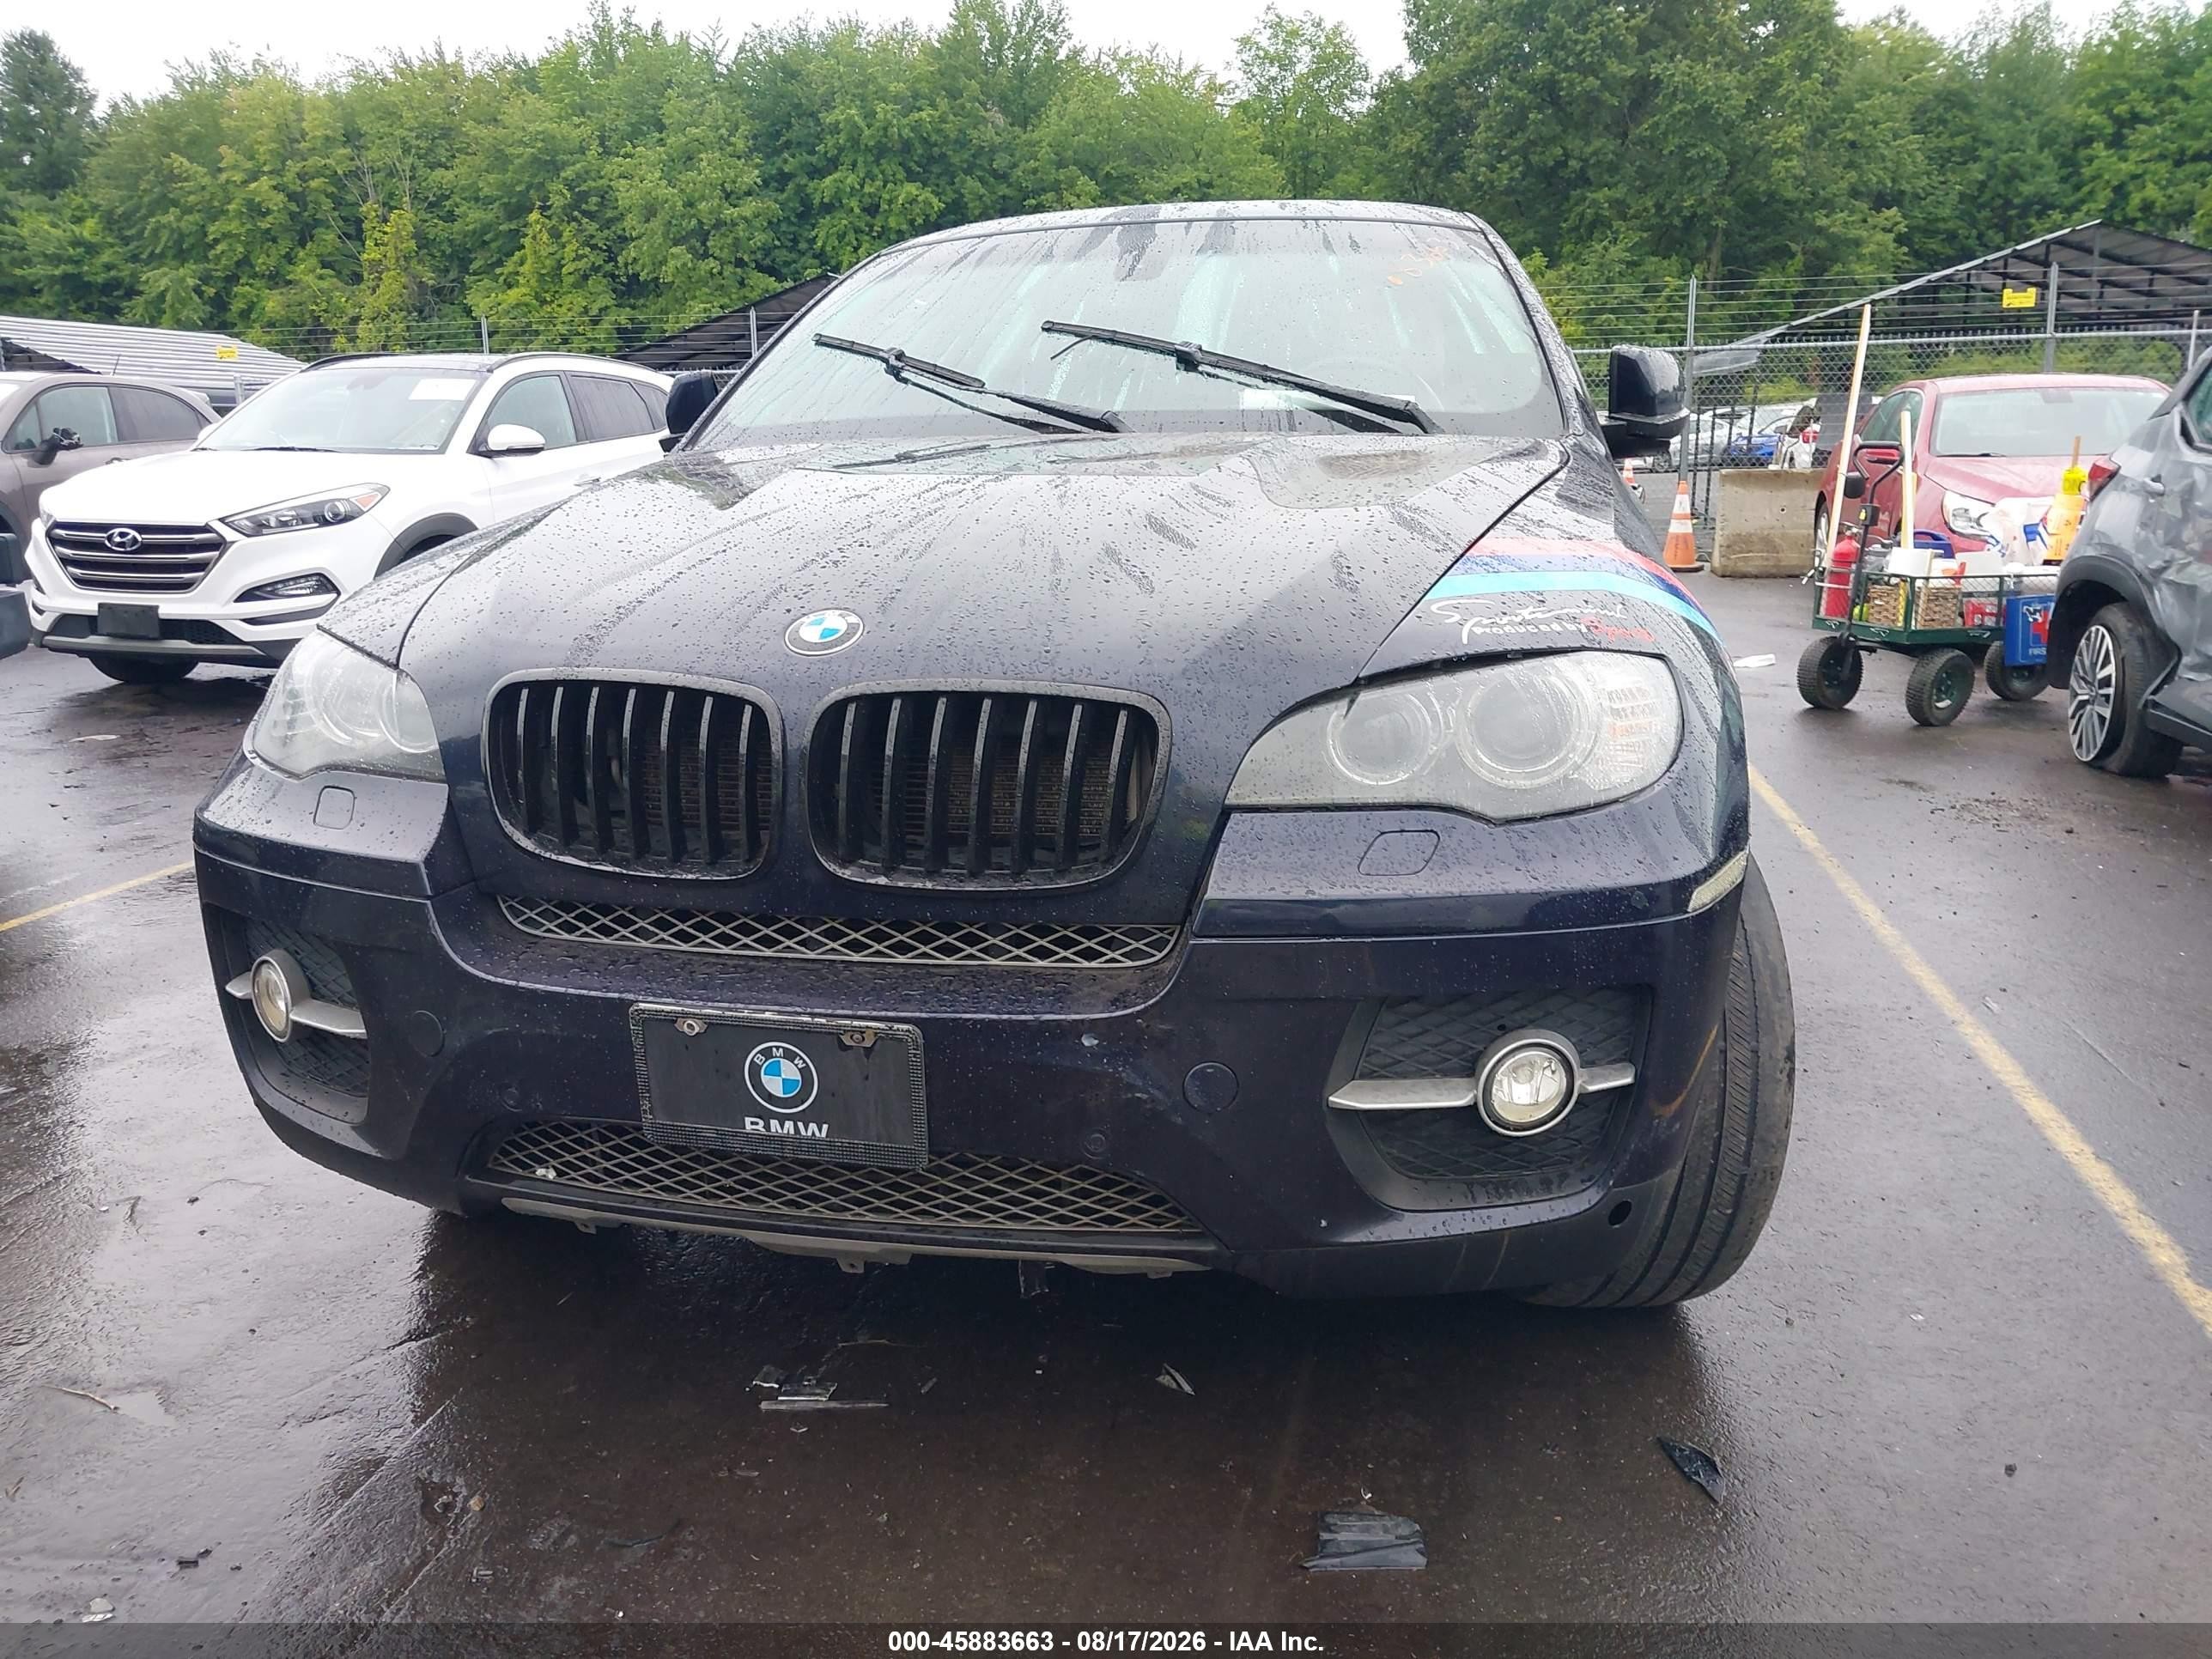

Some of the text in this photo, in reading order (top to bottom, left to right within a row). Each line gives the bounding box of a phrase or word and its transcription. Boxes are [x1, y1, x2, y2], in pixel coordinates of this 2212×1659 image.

[2028, 646, 2047, 656] FIRS
[753, 1047, 807, 1070] BMW
[744, 1116, 830, 1139] BMW
